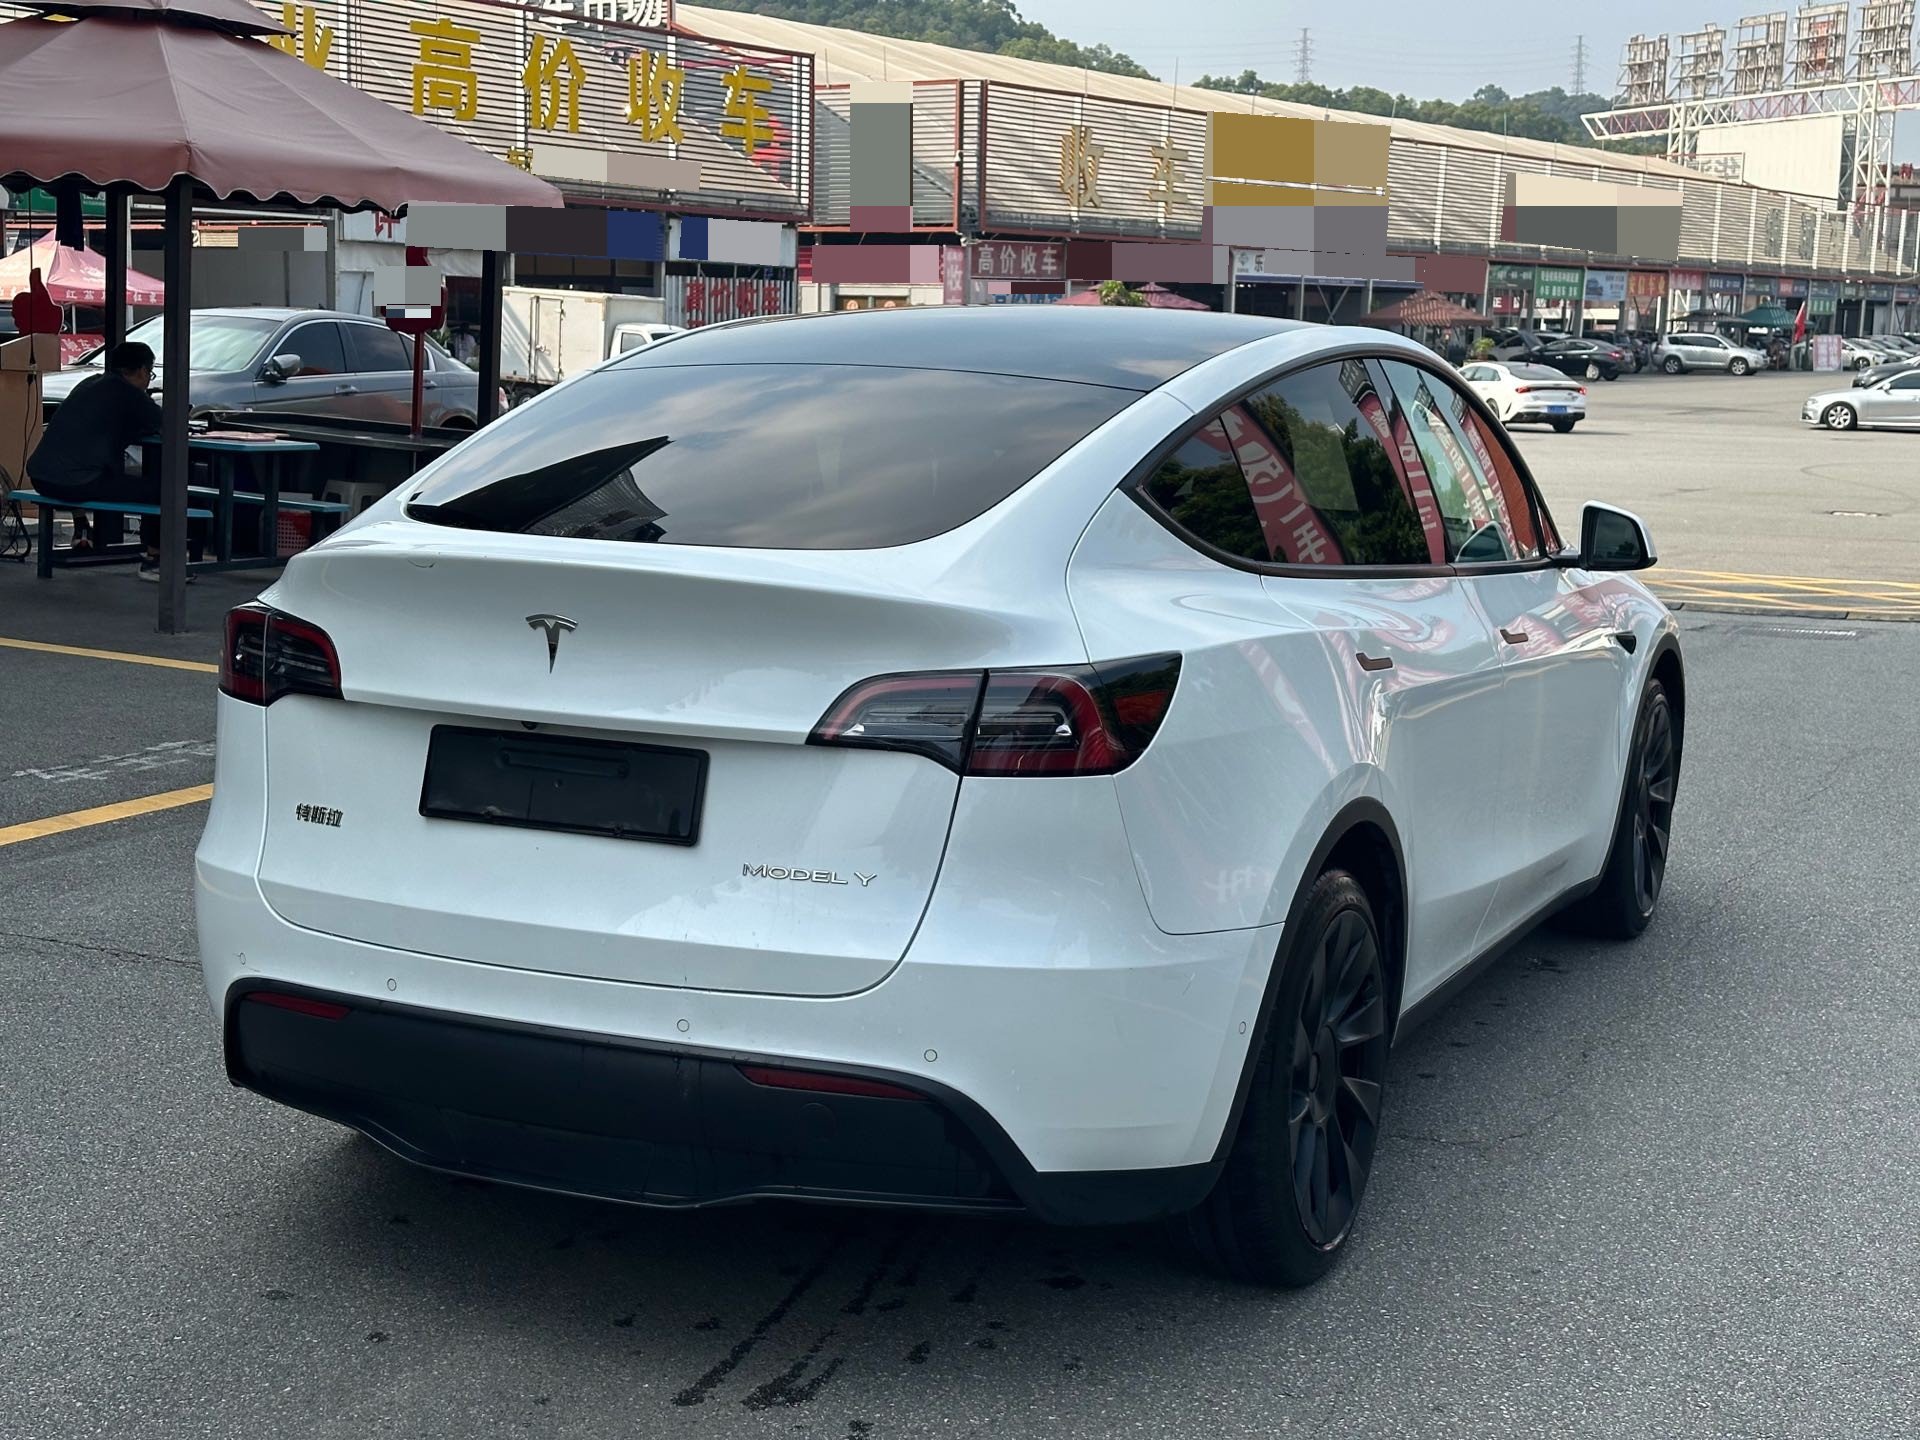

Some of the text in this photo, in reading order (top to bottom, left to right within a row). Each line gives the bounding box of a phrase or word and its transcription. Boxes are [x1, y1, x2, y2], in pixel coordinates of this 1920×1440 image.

[410, 18, 774, 155] 高价收车
[1060, 125, 1189, 215] 收车
[978, 244, 1057, 275] 高价收车
[686, 281, 780, 315] 高价收车
[296, 803, 344, 828] 特斯拉
[743, 862, 878, 887] MODEL Y
